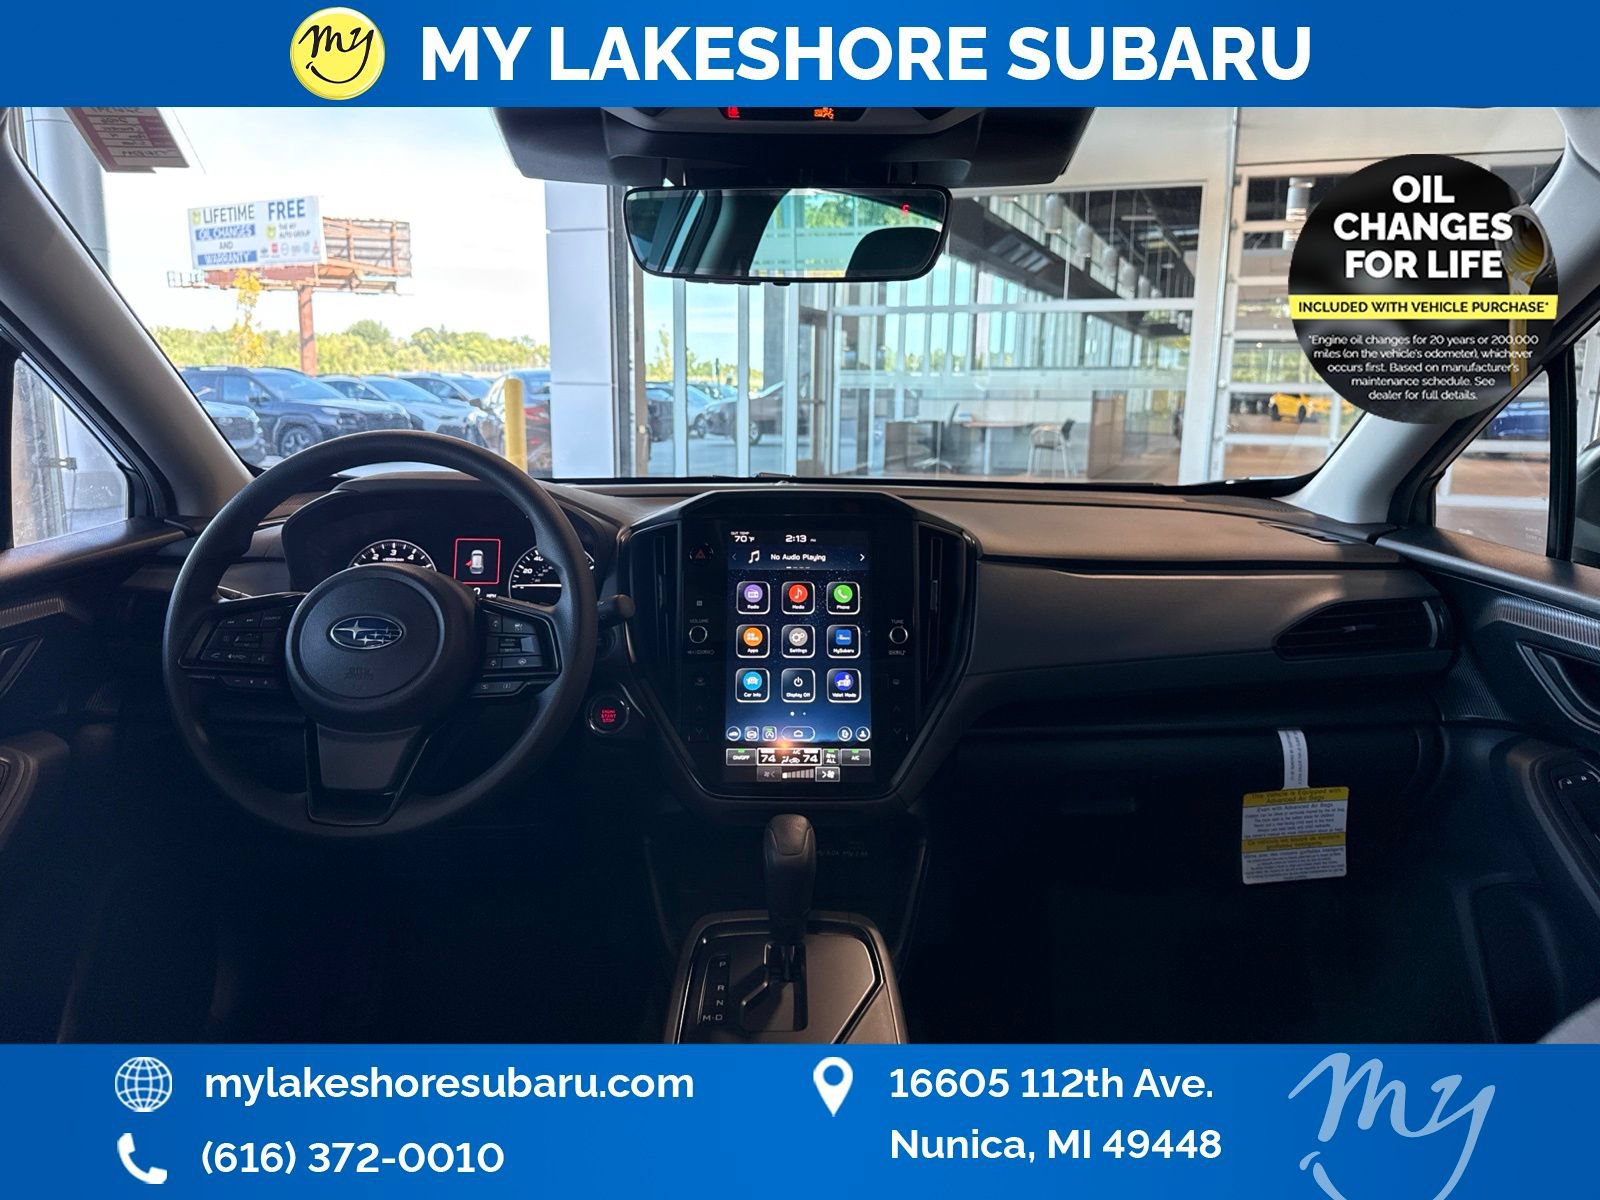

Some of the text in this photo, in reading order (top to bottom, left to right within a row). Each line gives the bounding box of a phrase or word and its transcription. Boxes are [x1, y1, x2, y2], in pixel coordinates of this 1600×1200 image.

[202, 204, 255, 224] LIFETIME
[268, 199, 306, 221] FREE
[212, 224, 252, 238] CHANGES
[219, 241, 234, 250] AND
[204, 251, 250, 265] WARRANTY
[734, 535, 748, 543] 70
[785, 534, 807, 543] 2:13
[372, 553, 380, 561] 2
[782, 553, 801, 561] Audio
[802, 553, 827, 562] Playing
[760, 754, 777, 763] 74
[803, 754, 819, 763] 74
[719, 960, 727, 968] P
[716, 999, 724, 1007] N
